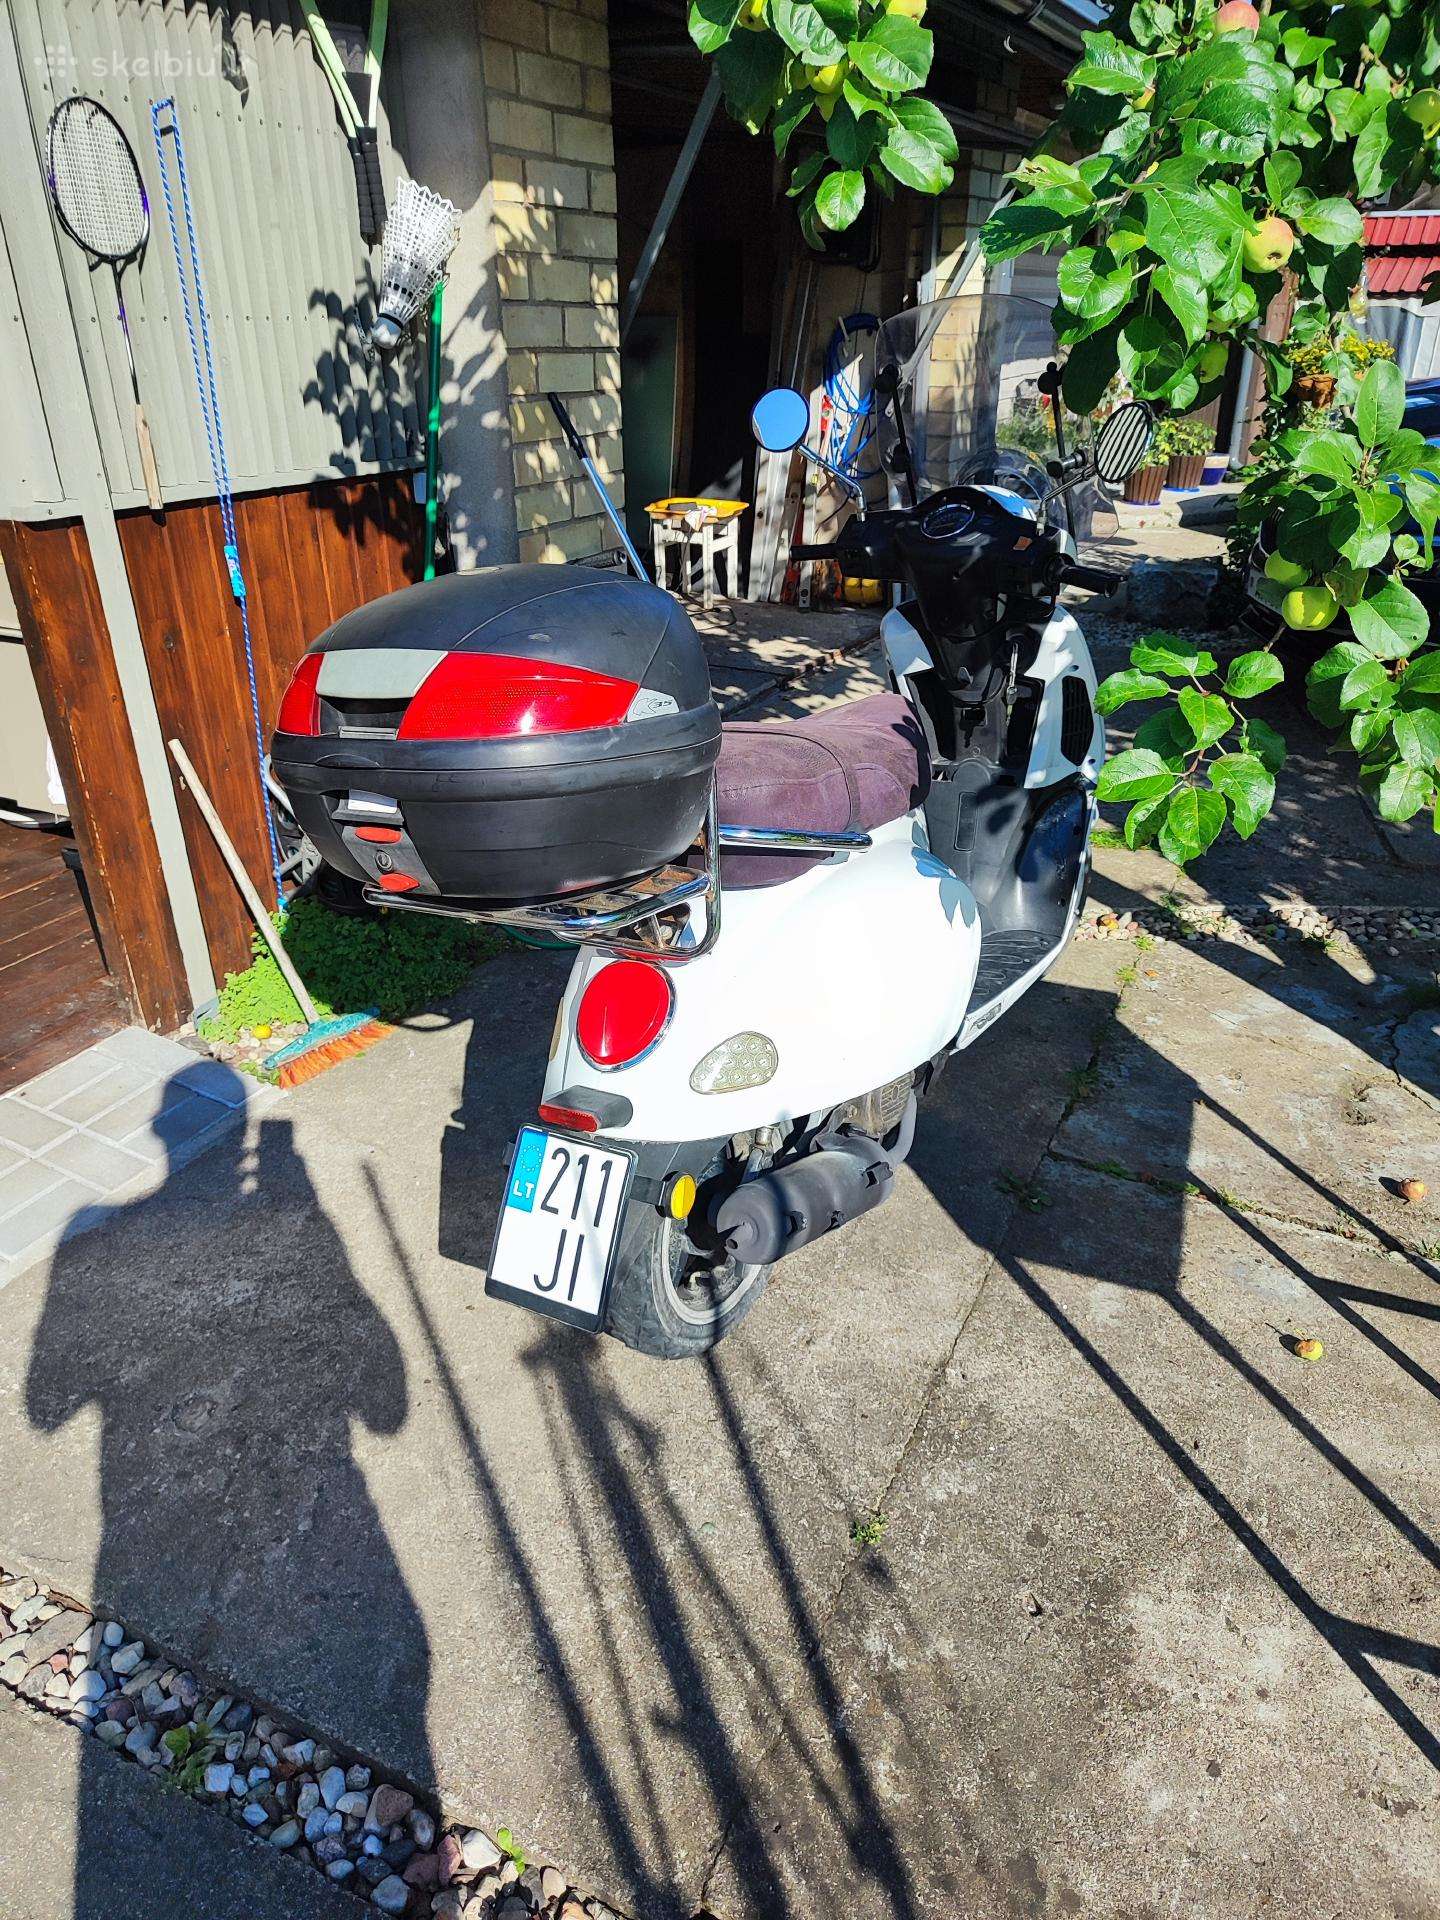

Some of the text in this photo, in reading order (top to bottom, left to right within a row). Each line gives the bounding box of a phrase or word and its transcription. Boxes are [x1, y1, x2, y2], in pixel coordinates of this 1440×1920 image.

[512, 1179, 535, 1199] LT
[540, 1147, 613, 1228] 211
[533, 1228, 585, 1302] JI
